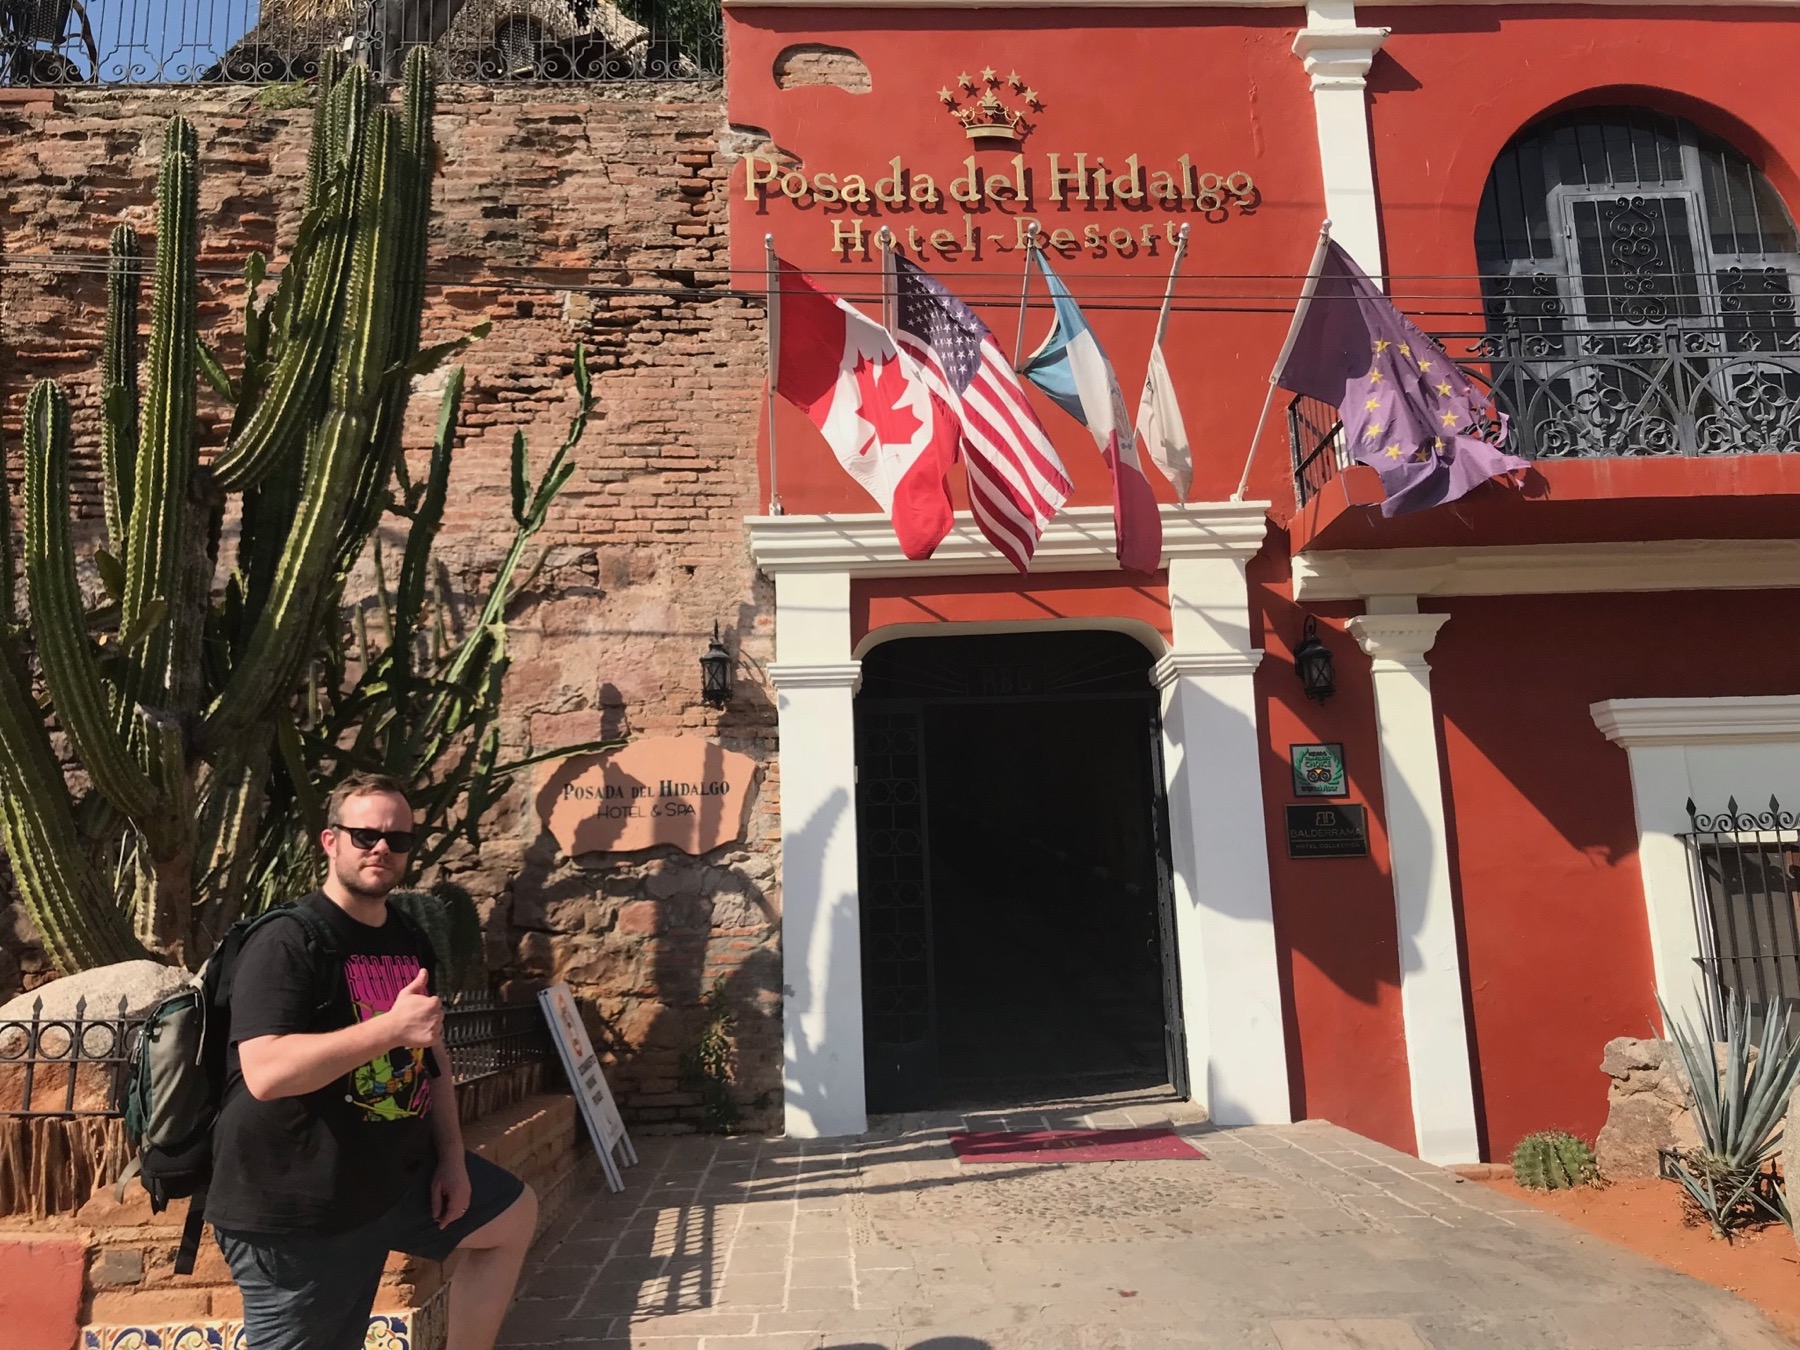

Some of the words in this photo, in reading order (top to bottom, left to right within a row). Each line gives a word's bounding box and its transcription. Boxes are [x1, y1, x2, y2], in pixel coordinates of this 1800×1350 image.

[744, 154, 939, 203] Posada
[949, 155, 1029, 202] del
[1047, 152, 1254, 211] Hidalgo
[831, 213, 976, 253] Hotel
[1013, 216, 1183, 250] Resort
[650, 804, 662, 817] &
